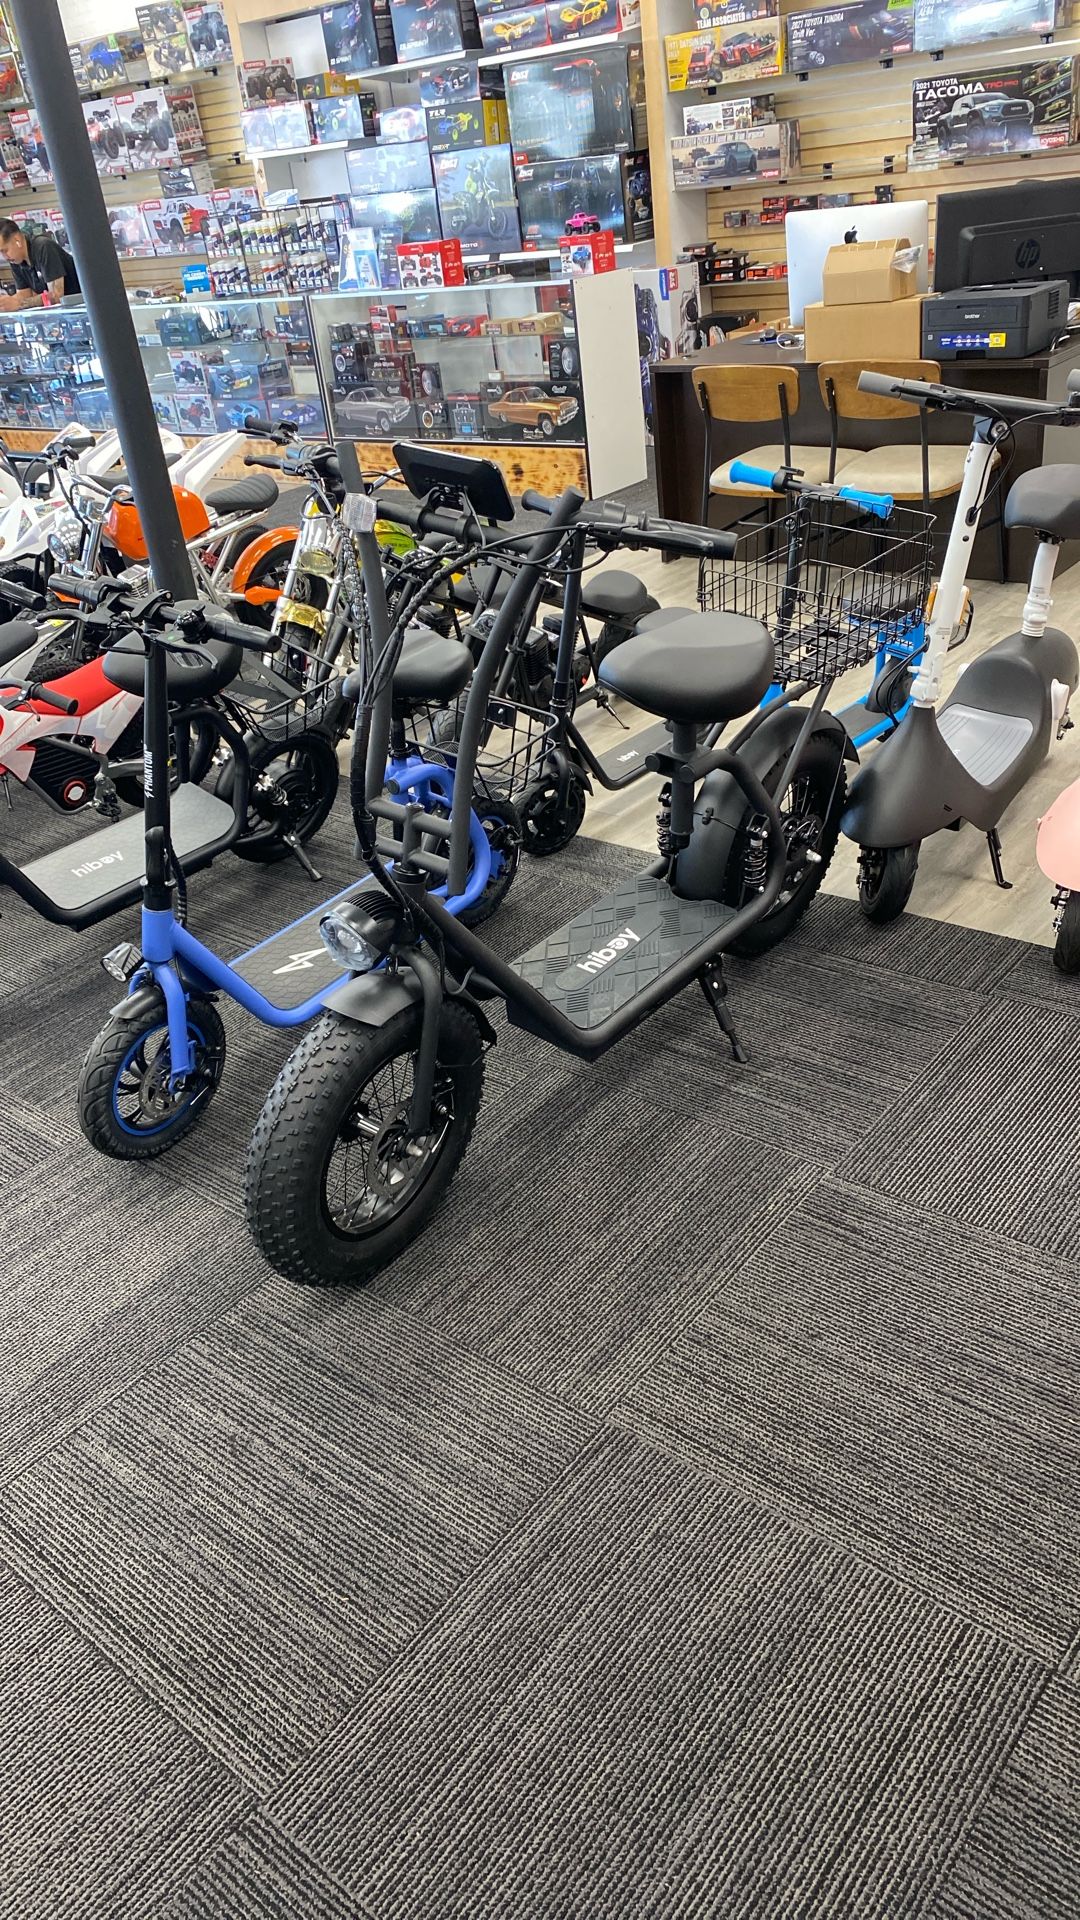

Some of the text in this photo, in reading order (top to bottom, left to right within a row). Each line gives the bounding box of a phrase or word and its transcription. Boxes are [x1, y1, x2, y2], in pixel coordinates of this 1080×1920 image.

[696, 12, 746, 29] TEAM ASSOCIATED
[804, 17, 823, 27] TOYOTA
[824, 12, 844, 24] TUNDRA
[915, 82, 986, 101] TACOMA
[916, 77, 959, 90] 2021 TOYOTA
[1041, 136, 1065, 146] KYOSHO
[1018, 240, 1038, 269] hp
[144, 750, 153, 791] PHANTOM
[70, 850, 124, 878] hiboy
[576, 927, 641, 974] hiboy
